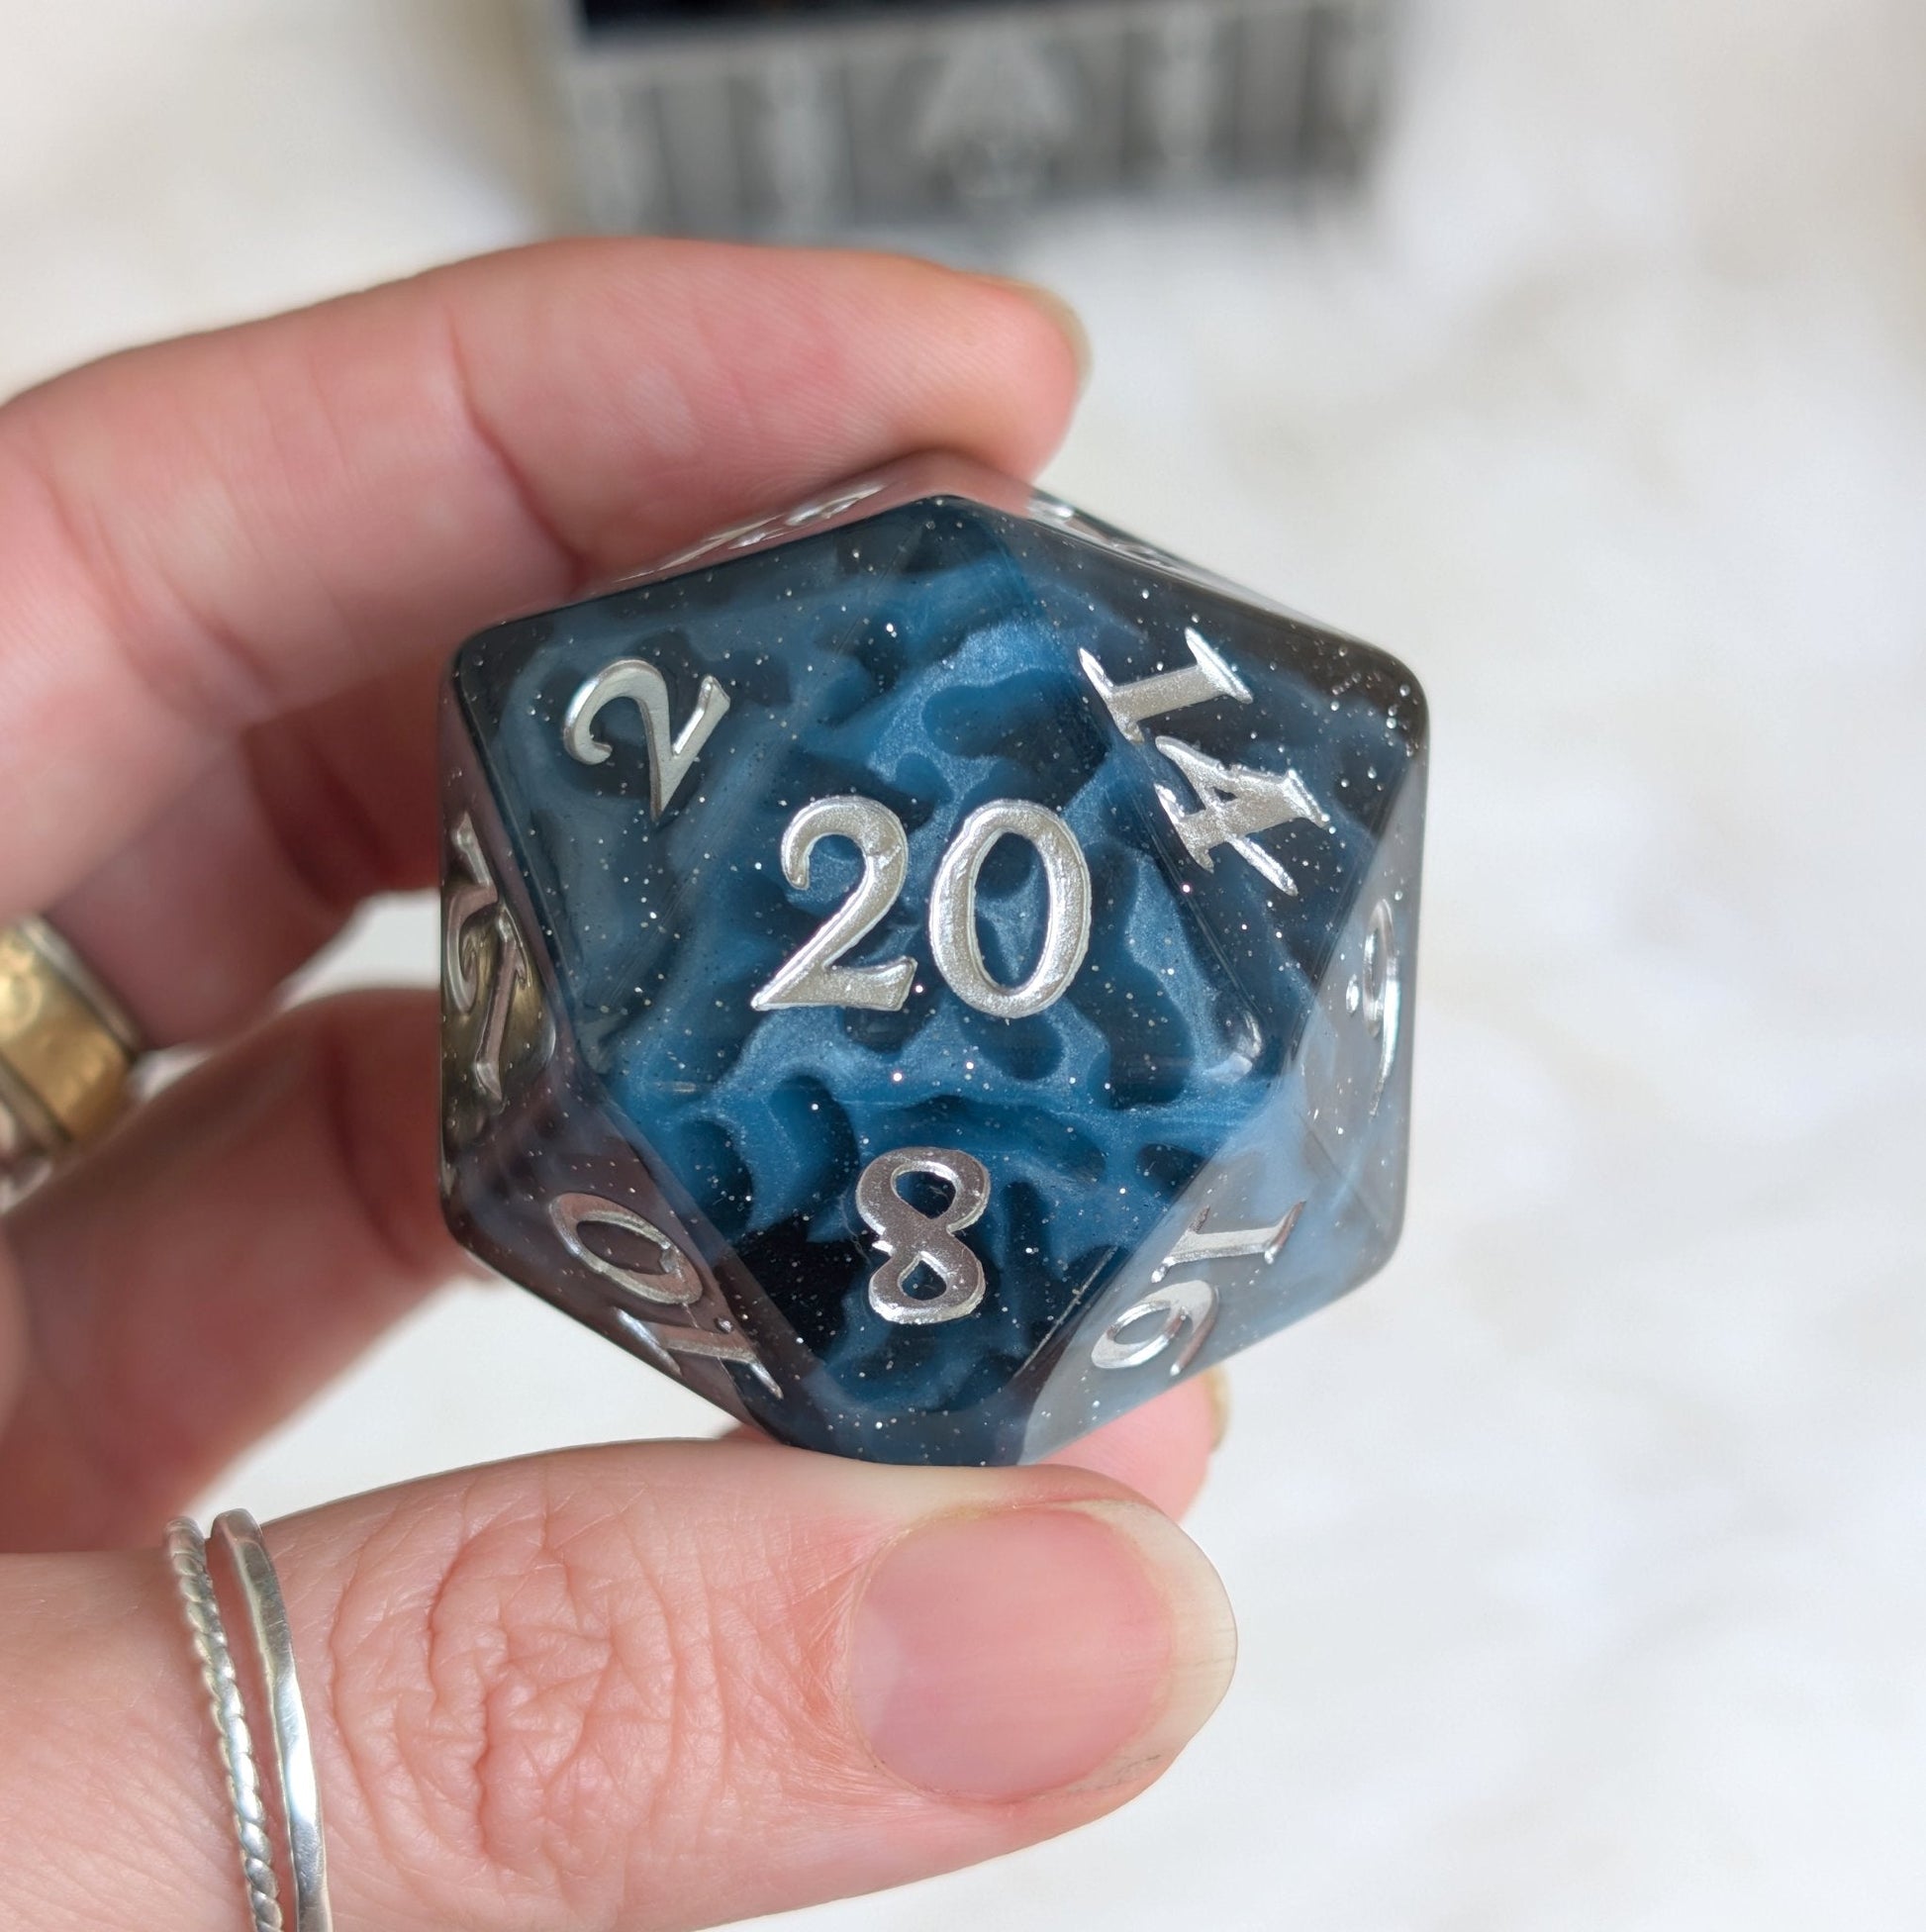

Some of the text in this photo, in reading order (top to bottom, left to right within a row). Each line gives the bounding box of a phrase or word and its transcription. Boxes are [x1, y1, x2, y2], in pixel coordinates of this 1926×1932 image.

[562, 658, 731, 825] 2
[1080, 627, 1330, 897] 14
[750, 795, 1094, 1019] 20
[549, 1193, 784, 1400] 10
[856, 1146, 991, 1324] 8
[1091, 1201, 1306, 1377] 16
